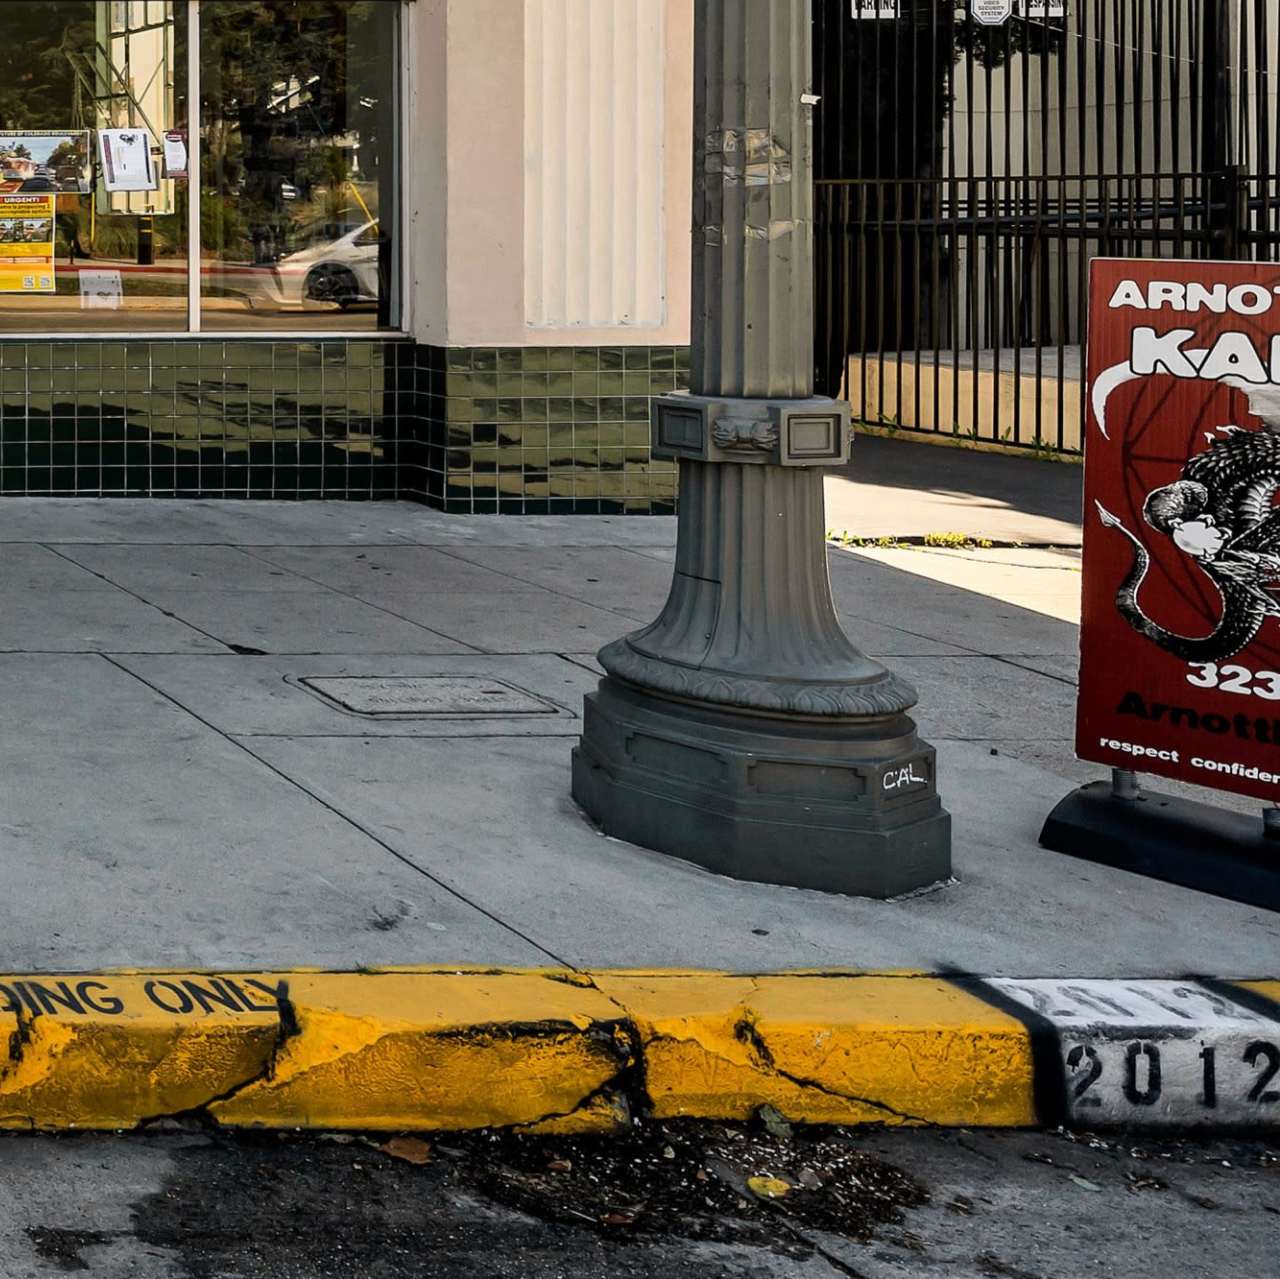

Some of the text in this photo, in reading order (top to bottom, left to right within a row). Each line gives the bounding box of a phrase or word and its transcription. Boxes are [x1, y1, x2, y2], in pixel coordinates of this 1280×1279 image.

[1108, 279, 1280, 315] ARNO
[1129, 325, 1280, 385] KA
[1186, 661, 1280, 700] 323
[1100, 737, 1179, 763] respect
[145, 978, 290, 1016] ONLY
[1066, 1040, 1280, 1109] 2012
